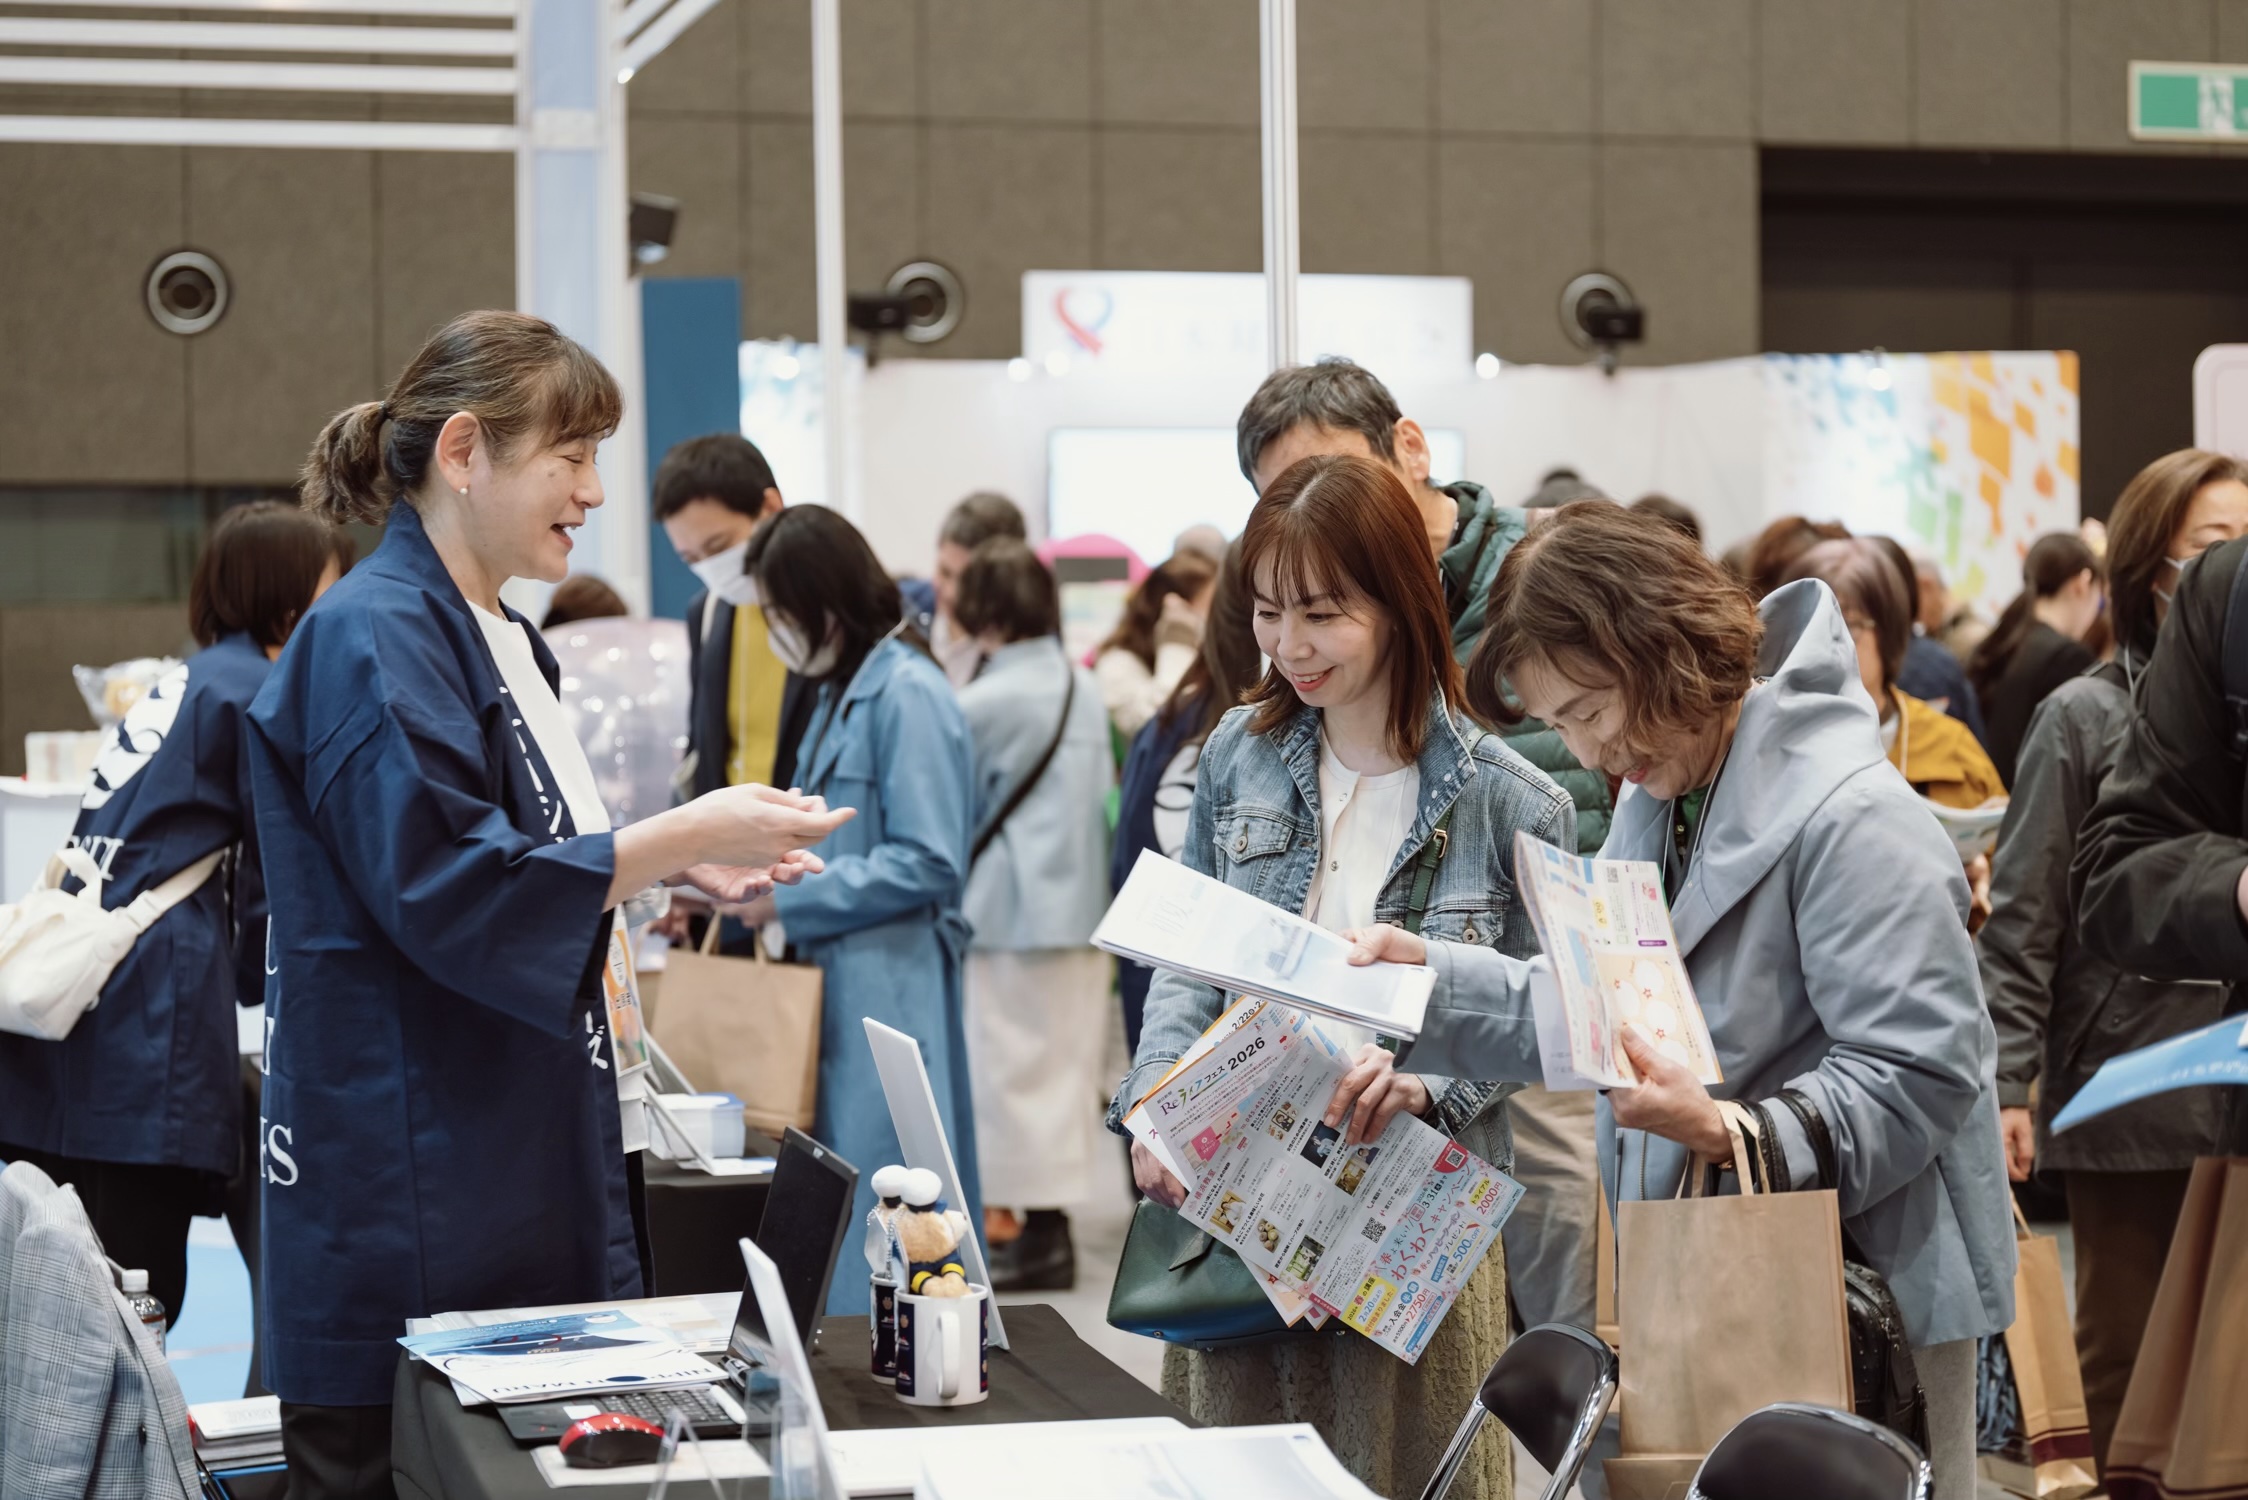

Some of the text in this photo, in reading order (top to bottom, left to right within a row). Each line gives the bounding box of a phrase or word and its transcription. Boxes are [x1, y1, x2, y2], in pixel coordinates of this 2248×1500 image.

[1226, 1035, 1266, 1071] 2026
[1193, 1168, 1216, 1200] 横浜教室
[1370, 1187, 1383, 1204] お電話で
[1470, 1178, 1490, 1205] トライアル
[1476, 1180, 1502, 1214] 2000円
[1390, 1162, 1470, 1281] わくわくキャンペーン
[1321, 1256, 1341, 1286] ホームページで
[1358, 1288, 1382, 1322] 2月20日より
[1405, 1286, 1430, 1319] 2750円
